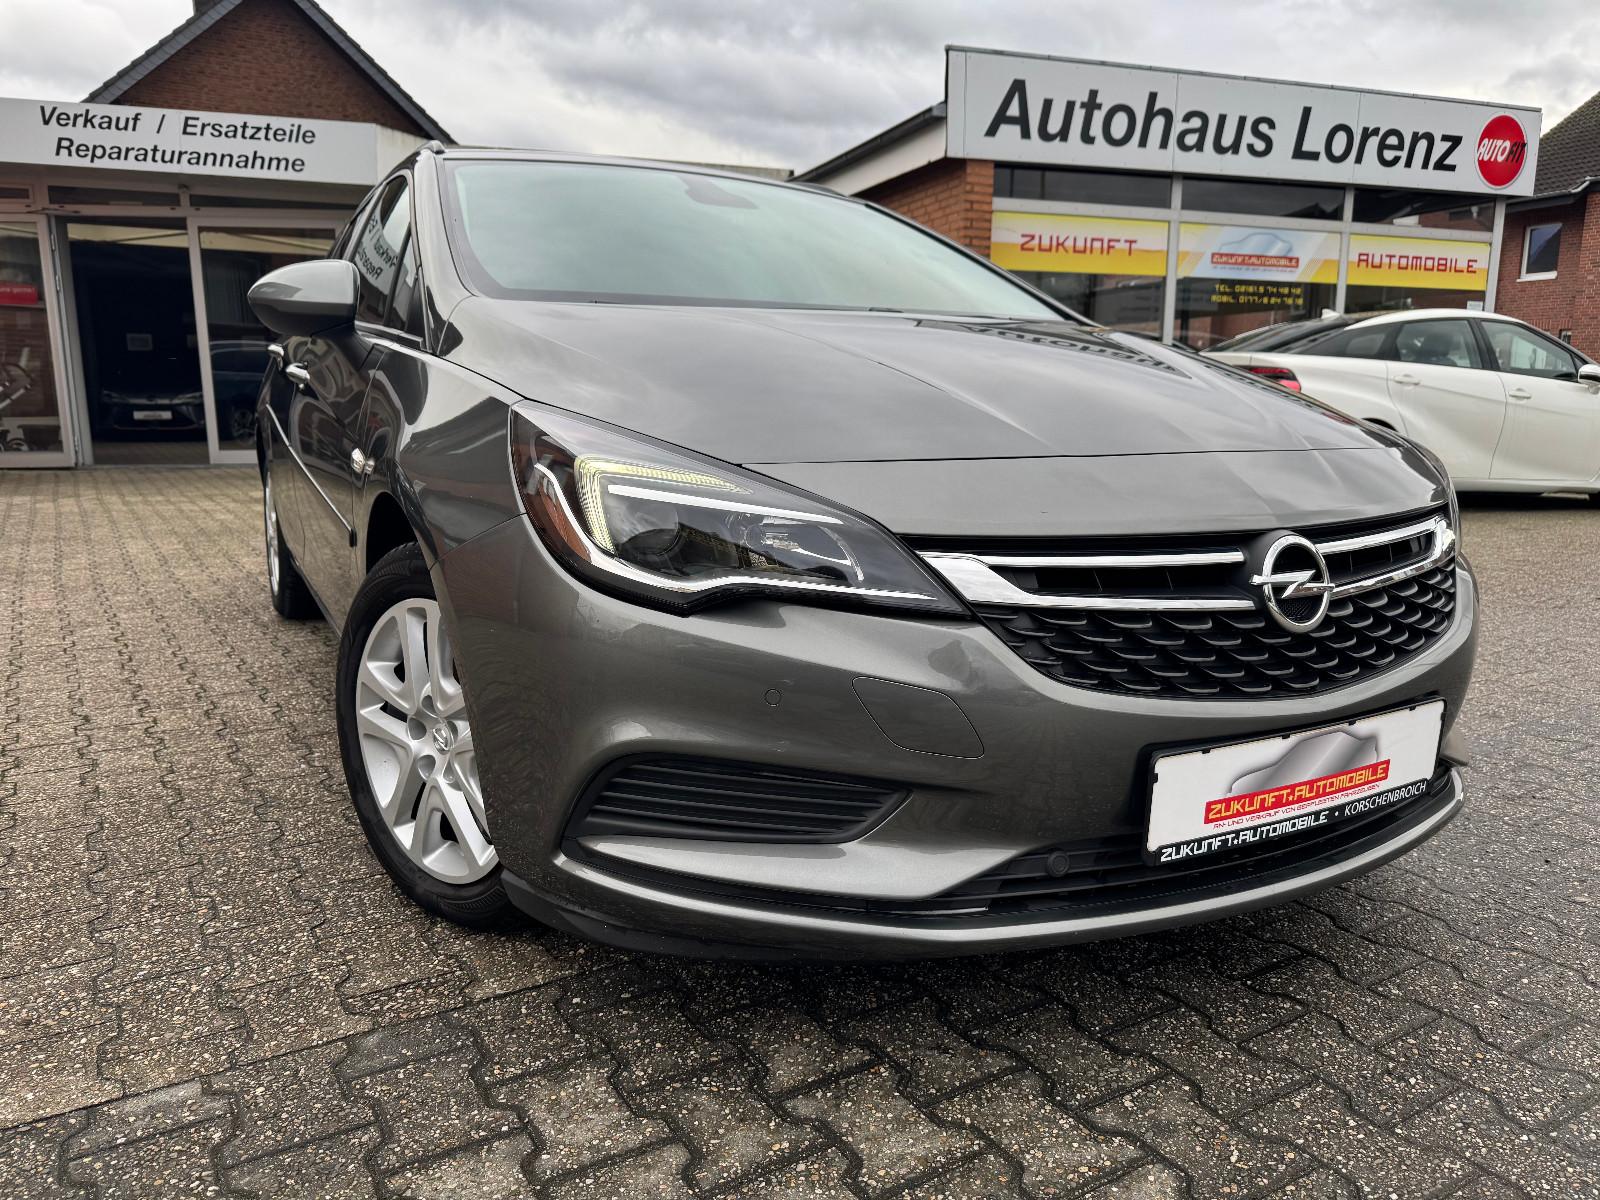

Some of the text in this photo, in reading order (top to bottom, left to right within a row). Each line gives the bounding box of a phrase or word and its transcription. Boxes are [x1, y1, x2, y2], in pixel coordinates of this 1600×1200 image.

[39, 105, 317, 144] Verkauf / Ersatzteile
[984, 78, 1464, 172] Autohaus Lorenz
[54, 136, 306, 172] Reparaturannahme
[1020, 233, 1138, 257] ZUKUNFT
[1357, 252, 1479, 275] AUTOMOBILE
[1227, 818, 1244, 827] UND
[1245, 810, 1281, 822] VERKAUF
[1281, 807, 1296, 815] VON
[1344, 781, 1427, 817] KORSCHENBROICH
